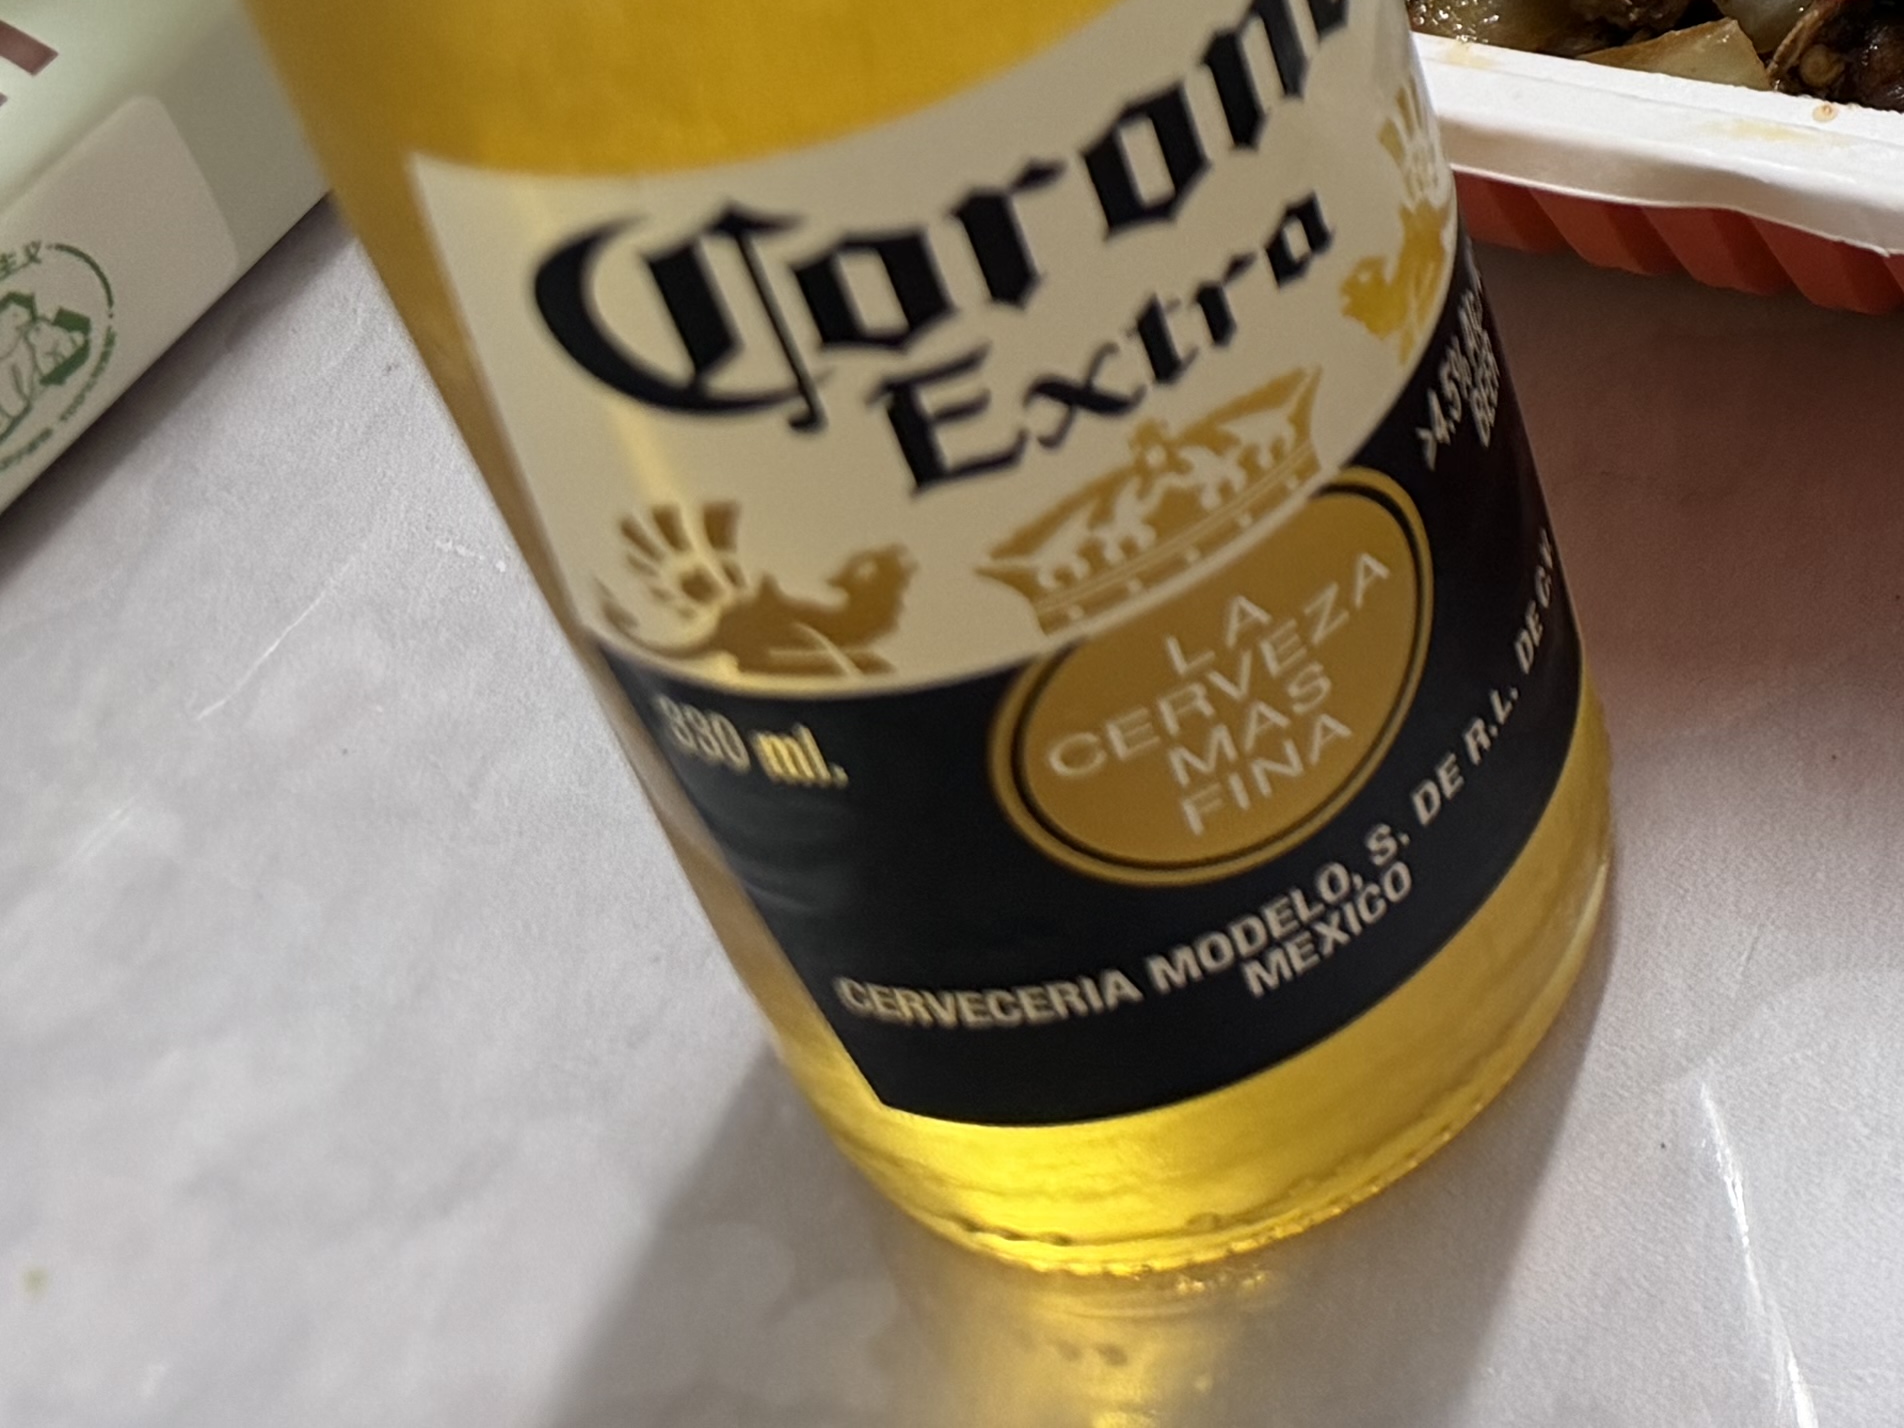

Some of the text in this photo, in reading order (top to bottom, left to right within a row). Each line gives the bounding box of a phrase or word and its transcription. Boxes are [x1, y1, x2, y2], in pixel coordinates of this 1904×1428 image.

[866, 190, 1336, 500] Extra
[1048, 552, 1391, 778] CERVEZA
[1166, 594, 1272, 676] LA
[1167, 660, 1333, 787] MAS
[1180, 712, 1353, 837] FINA
[831, 967, 1145, 1029] CERVECERIA
[1364, 822, 1411, 867] S.
[1409, 751, 1466, 828] DE
[1461, 685, 1520, 767] R.L.
[1513, 598, 1545, 675] DE
[1239, 860, 1414, 1000] MEXICO
